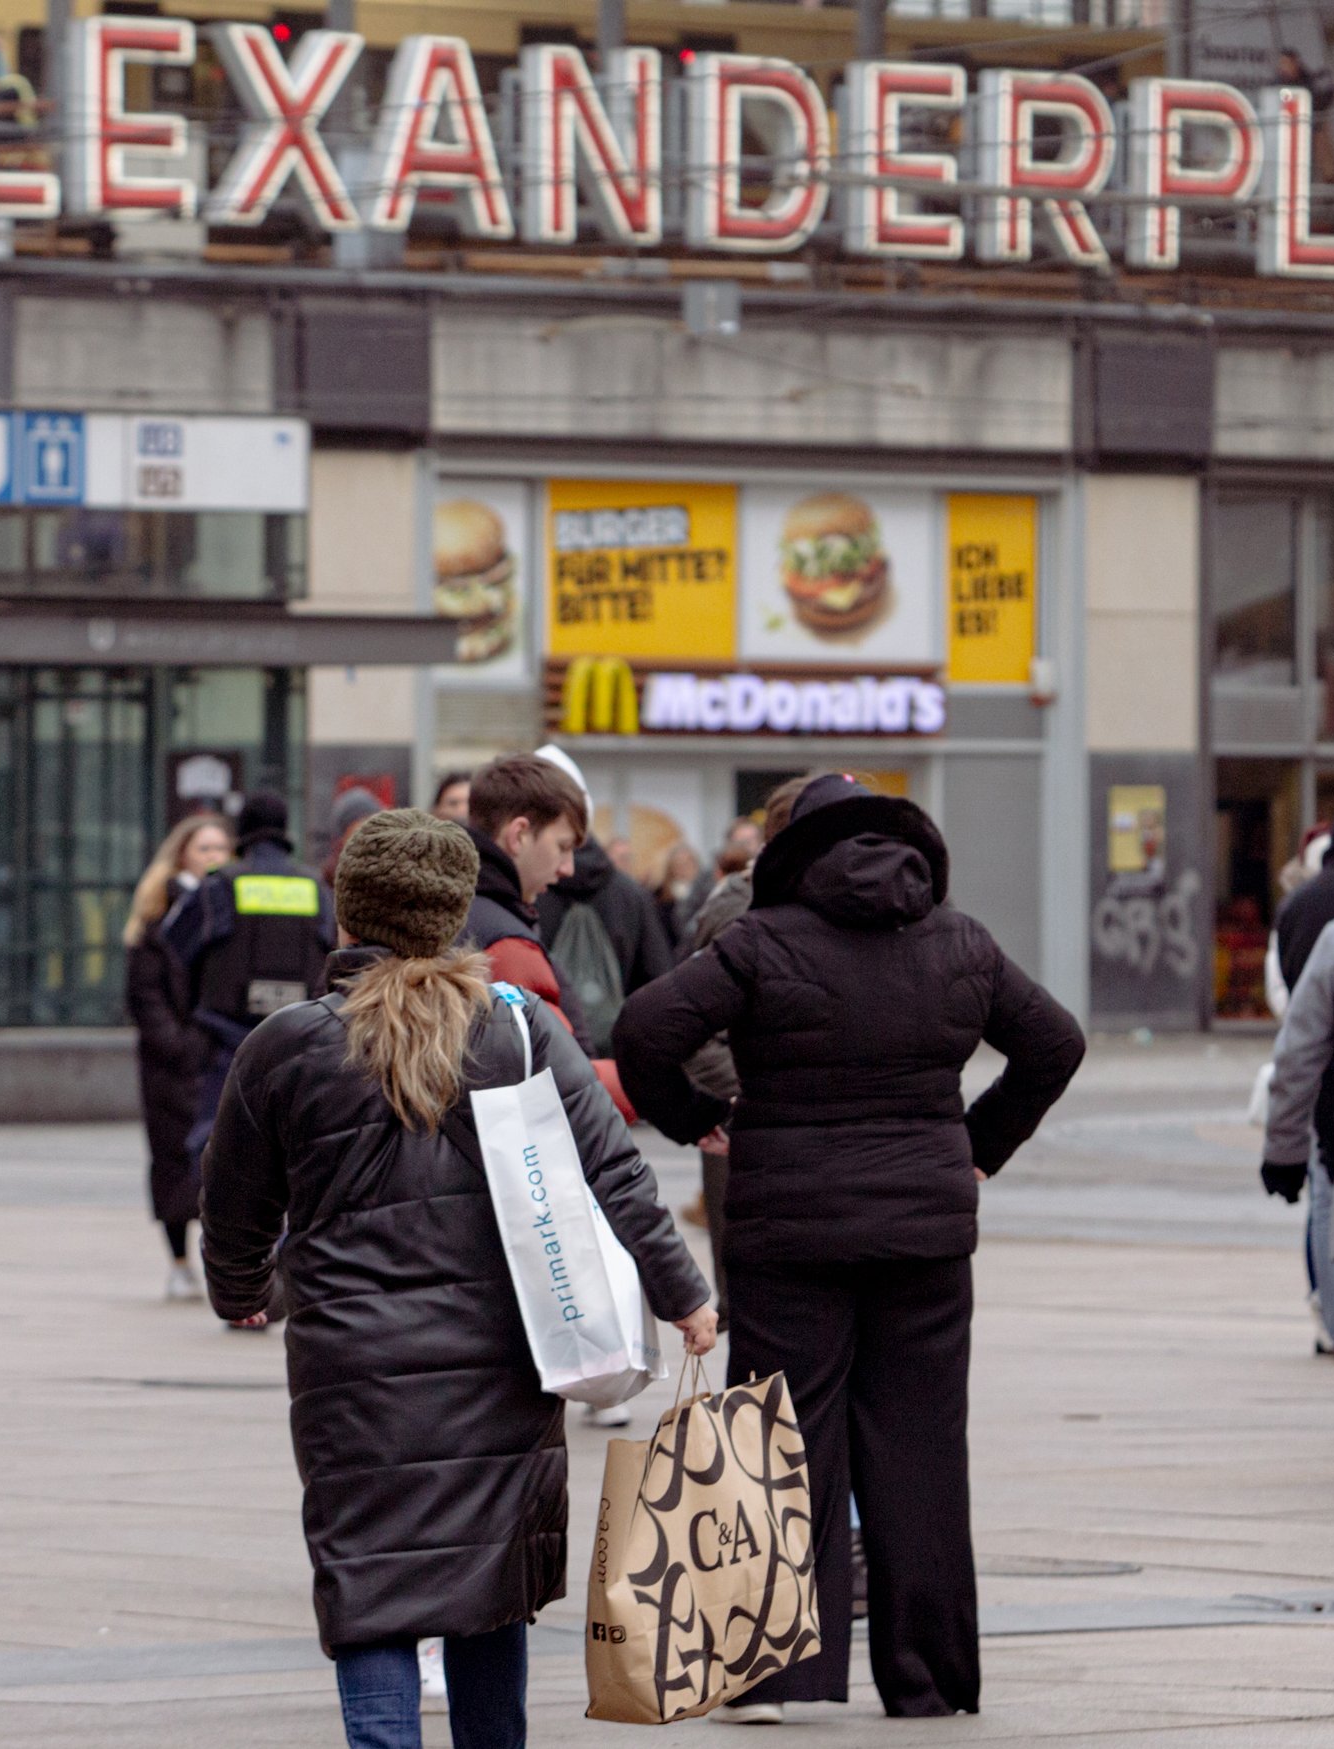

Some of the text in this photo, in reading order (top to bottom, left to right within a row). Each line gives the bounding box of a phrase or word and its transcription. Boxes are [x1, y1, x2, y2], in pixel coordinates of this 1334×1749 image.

[556, 507, 688, 551] BURGER
[557, 549, 725, 585] FÜR MITTE?
[955, 542, 998, 571] ICH
[558, 586, 653, 626] BITTE!
[956, 571, 1026, 603] LIEBE
[956, 608, 998, 638] ES!
[642, 673, 946, 733] McDonald's
[522, 1143, 585, 1322] primark.com
[596, 1496, 612, 1585] c-a.com
[688, 1498, 763, 1573] C&A
